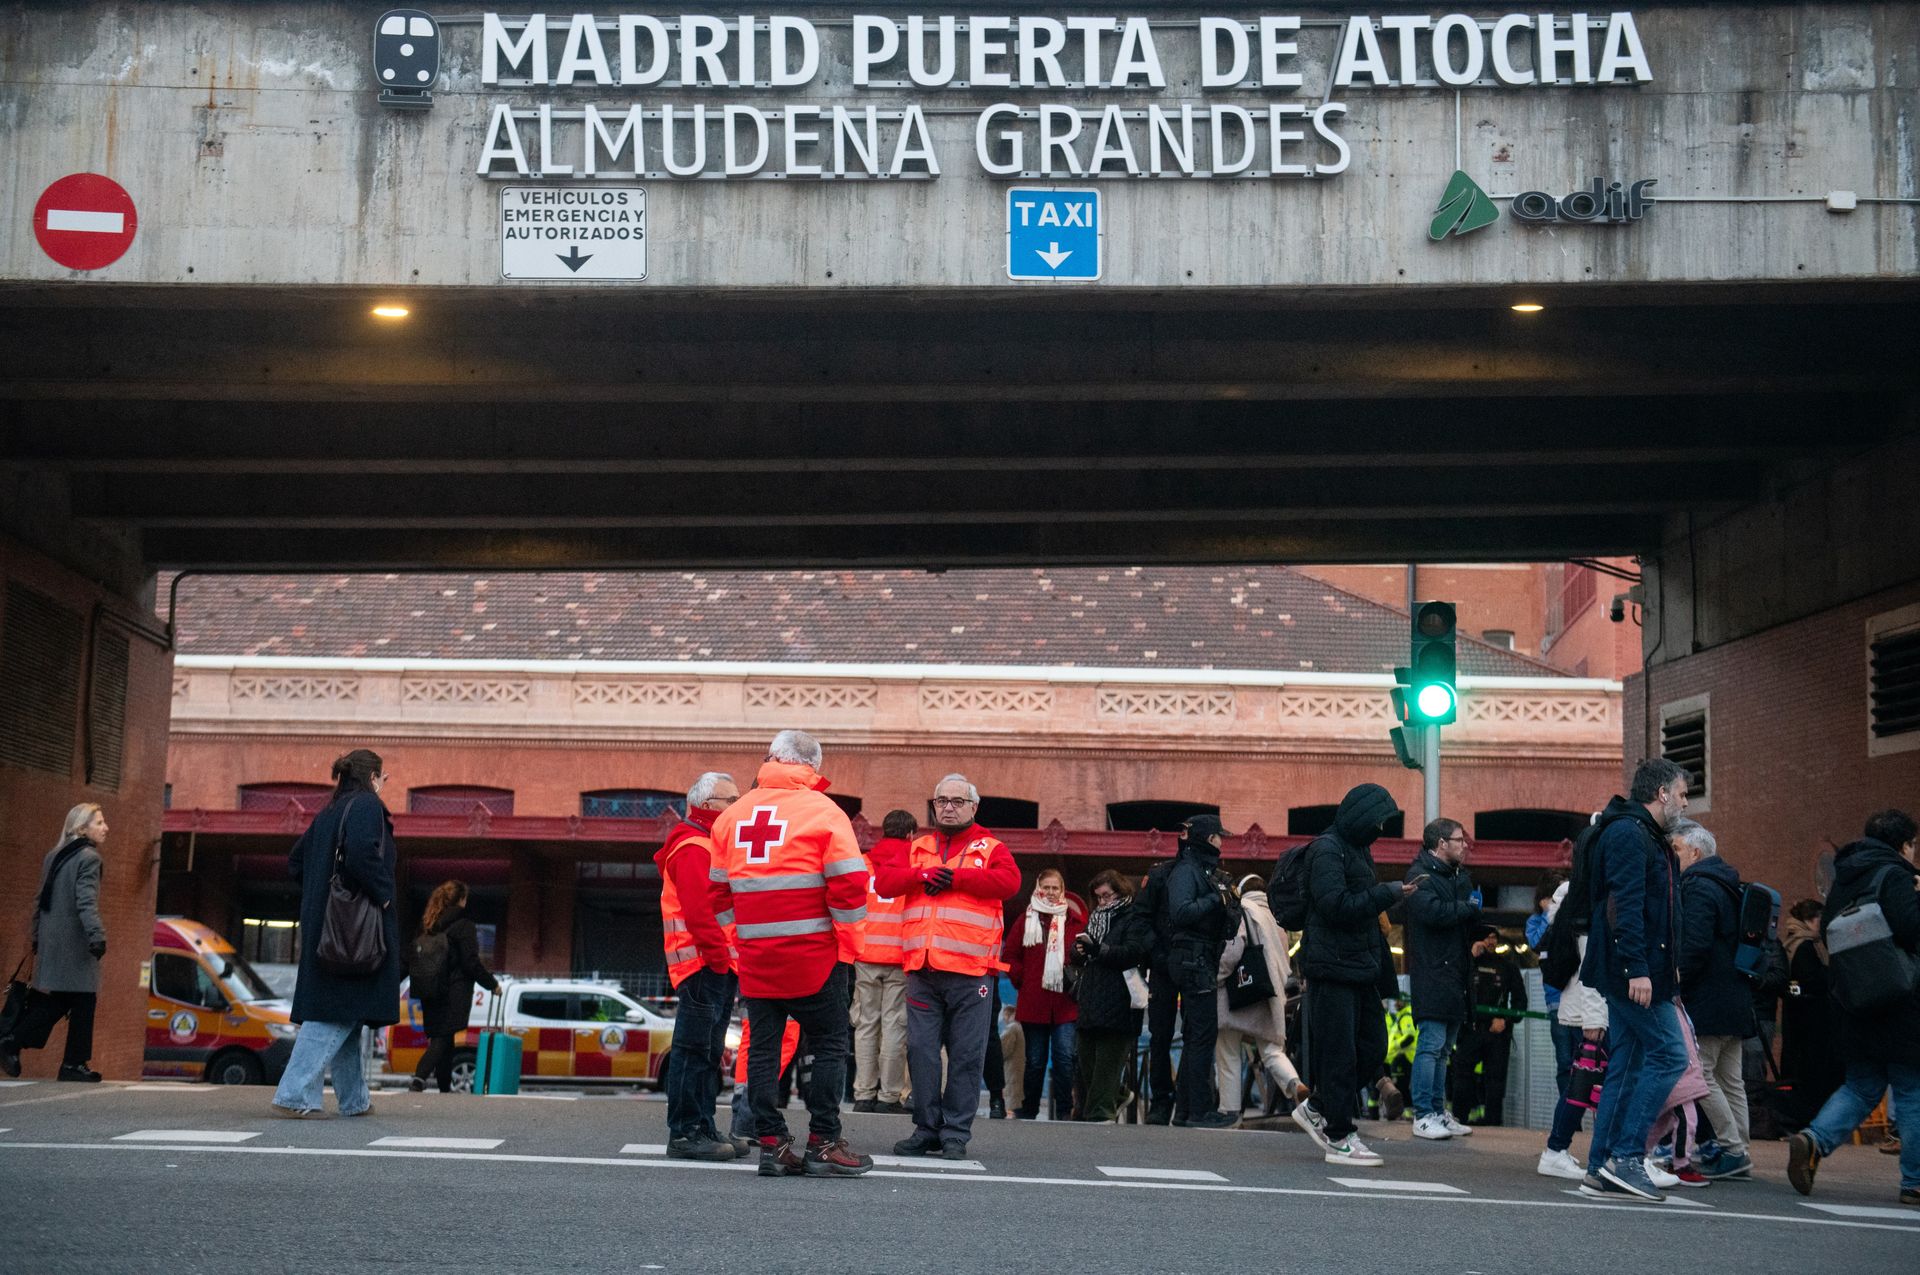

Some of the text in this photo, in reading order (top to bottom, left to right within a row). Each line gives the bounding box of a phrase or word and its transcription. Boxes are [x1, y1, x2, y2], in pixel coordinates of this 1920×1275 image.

[481, 12, 1654, 90] MADRID PUERTA DE ATOCHA
[477, 102, 1351, 179] ALMUDENA GRANDES
[520, 190, 628, 205] VEHÍCULOS
[1511, 177, 1658, 222] adif
[504, 209, 630, 222] EMERGENCIA
[1015, 202, 1093, 227] TAXI
[505, 227, 644, 240] AUTORIZADOS
